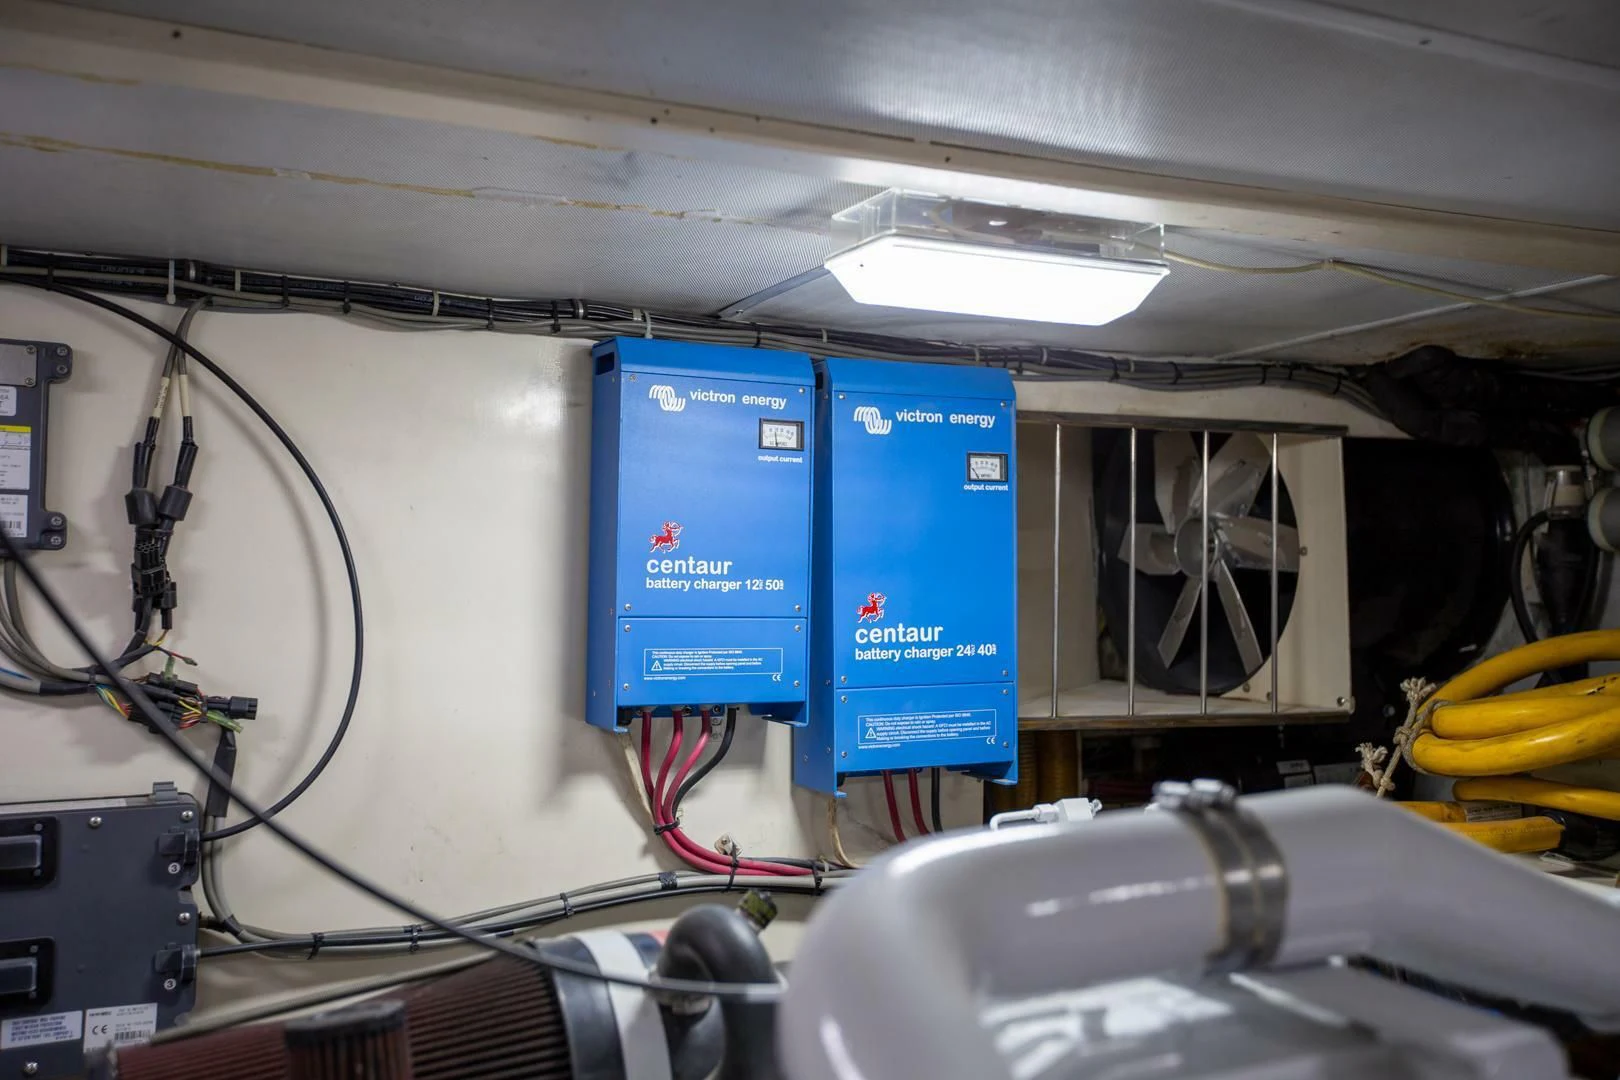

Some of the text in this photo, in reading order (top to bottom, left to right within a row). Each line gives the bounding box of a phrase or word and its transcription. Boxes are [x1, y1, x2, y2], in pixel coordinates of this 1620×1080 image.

[690, 390, 787, 409] victron energy
[896, 409, 996, 428] victron energy
[646, 556, 732, 575] centaur
[646, 577, 691, 592] battery
[694, 579, 742, 592] charger
[855, 623, 943, 643] centaur
[856, 648, 901, 662] battery
[904, 646, 953, 660] charger
